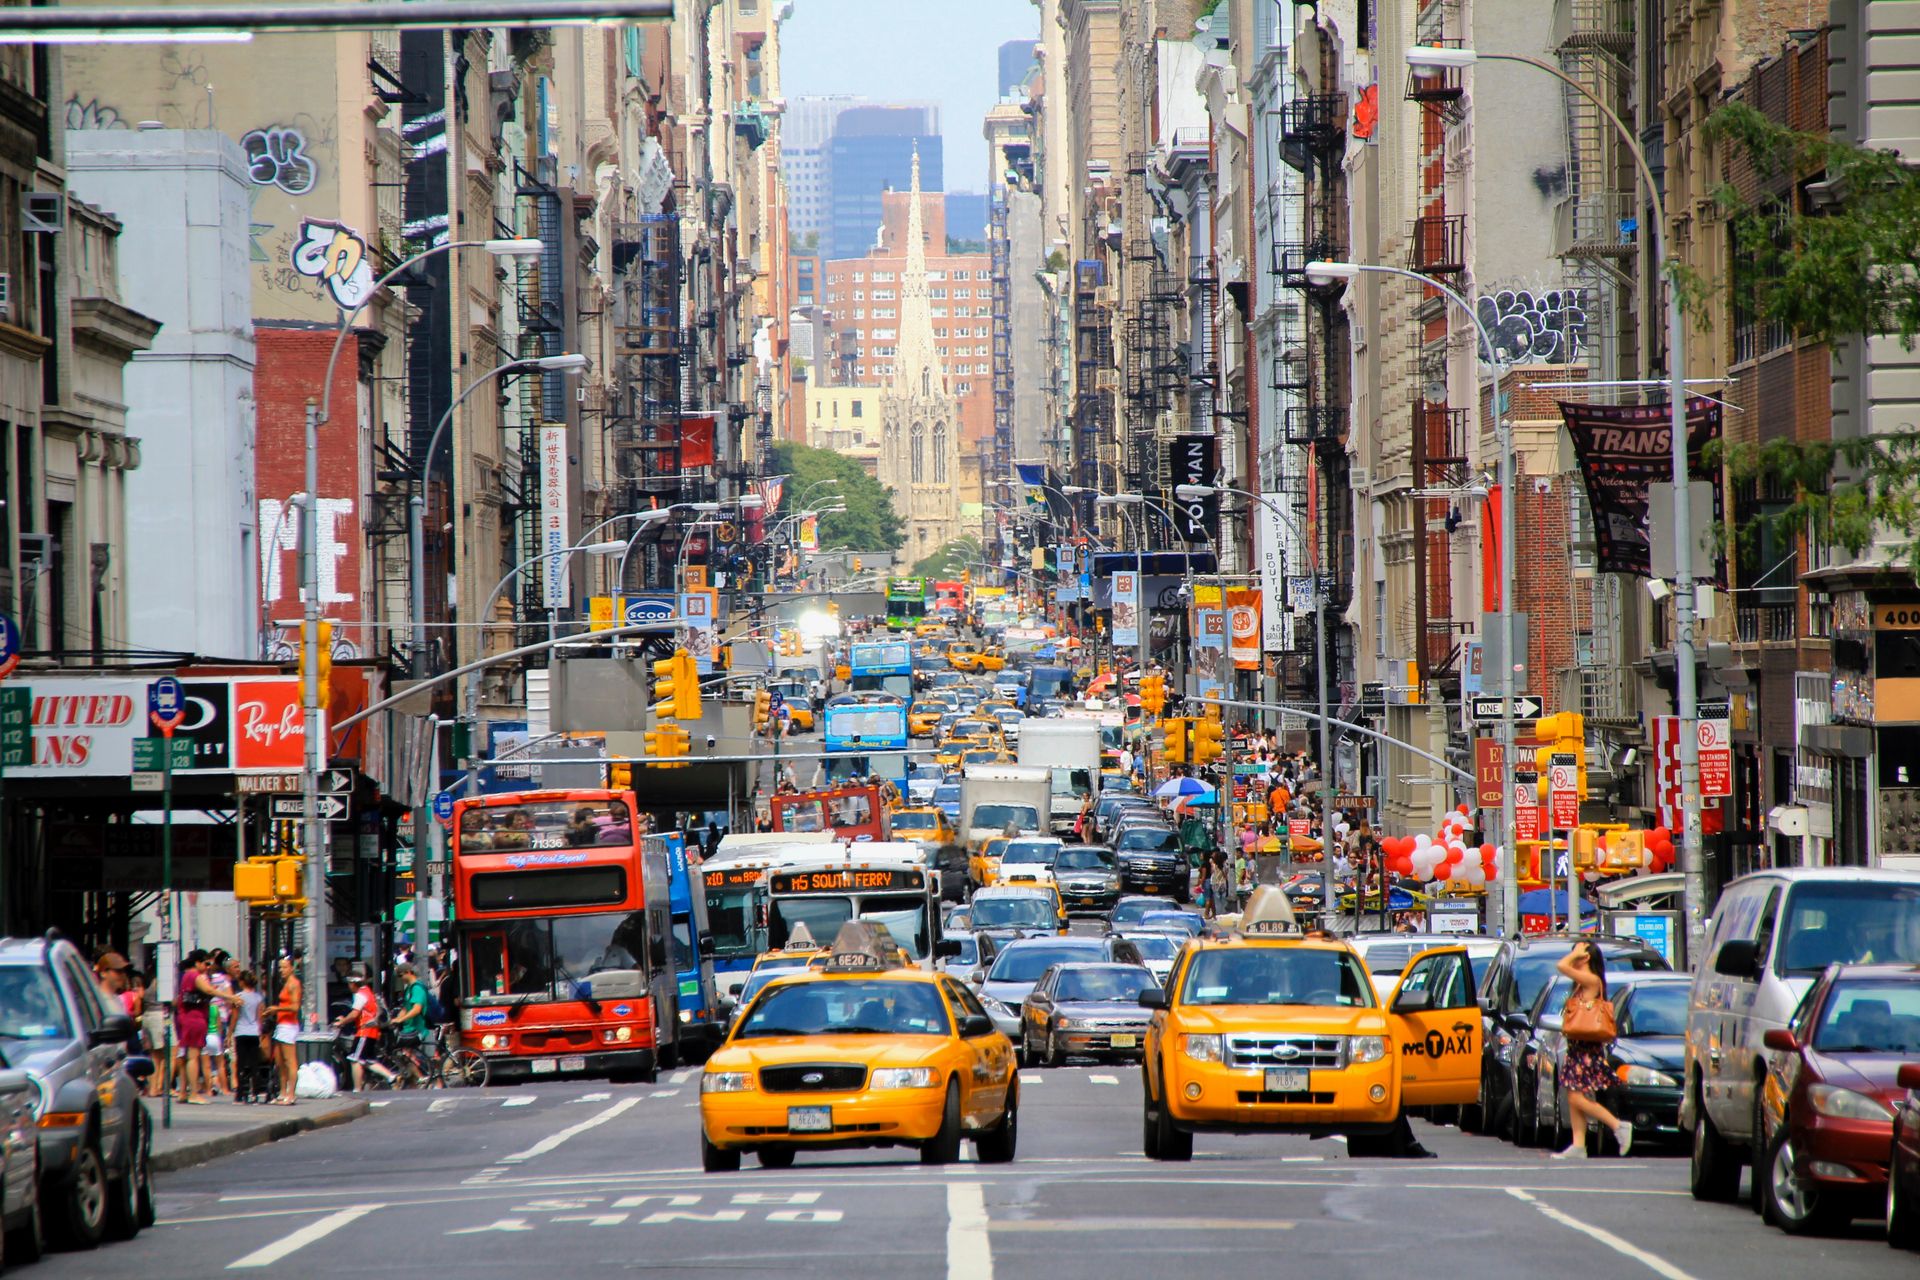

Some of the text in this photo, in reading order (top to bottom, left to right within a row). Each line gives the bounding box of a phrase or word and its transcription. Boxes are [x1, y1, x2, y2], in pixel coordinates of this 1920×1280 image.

[1591, 426, 1697, 454] TRANST
[1208, 616, 1223, 624] MO
[1885, 610, 1920, 625] 400
[1479, 704, 1499, 714] ONE
[238, 701, 304, 747] Ray-Ba
[1706, 753, 1728, 761] STANDING
[238, 775, 299, 791] WALKER ST
[281, 801, 304, 812] ONE
[1335, 799, 1373, 808] CANAL ST
[531, 838, 563, 849] 71336
[705, 871, 724, 886] x10
[791, 871, 892, 891] M5 SOUTH FERRY
[1443, 901, 1466, 909] Phone
[1259, 922, 1284, 933] 9L89
[838, 954, 864, 966] 6E20
[1402, 1030, 1473, 1057] NYC TAXI
[1275, 1075, 1294, 1087] 9L89
